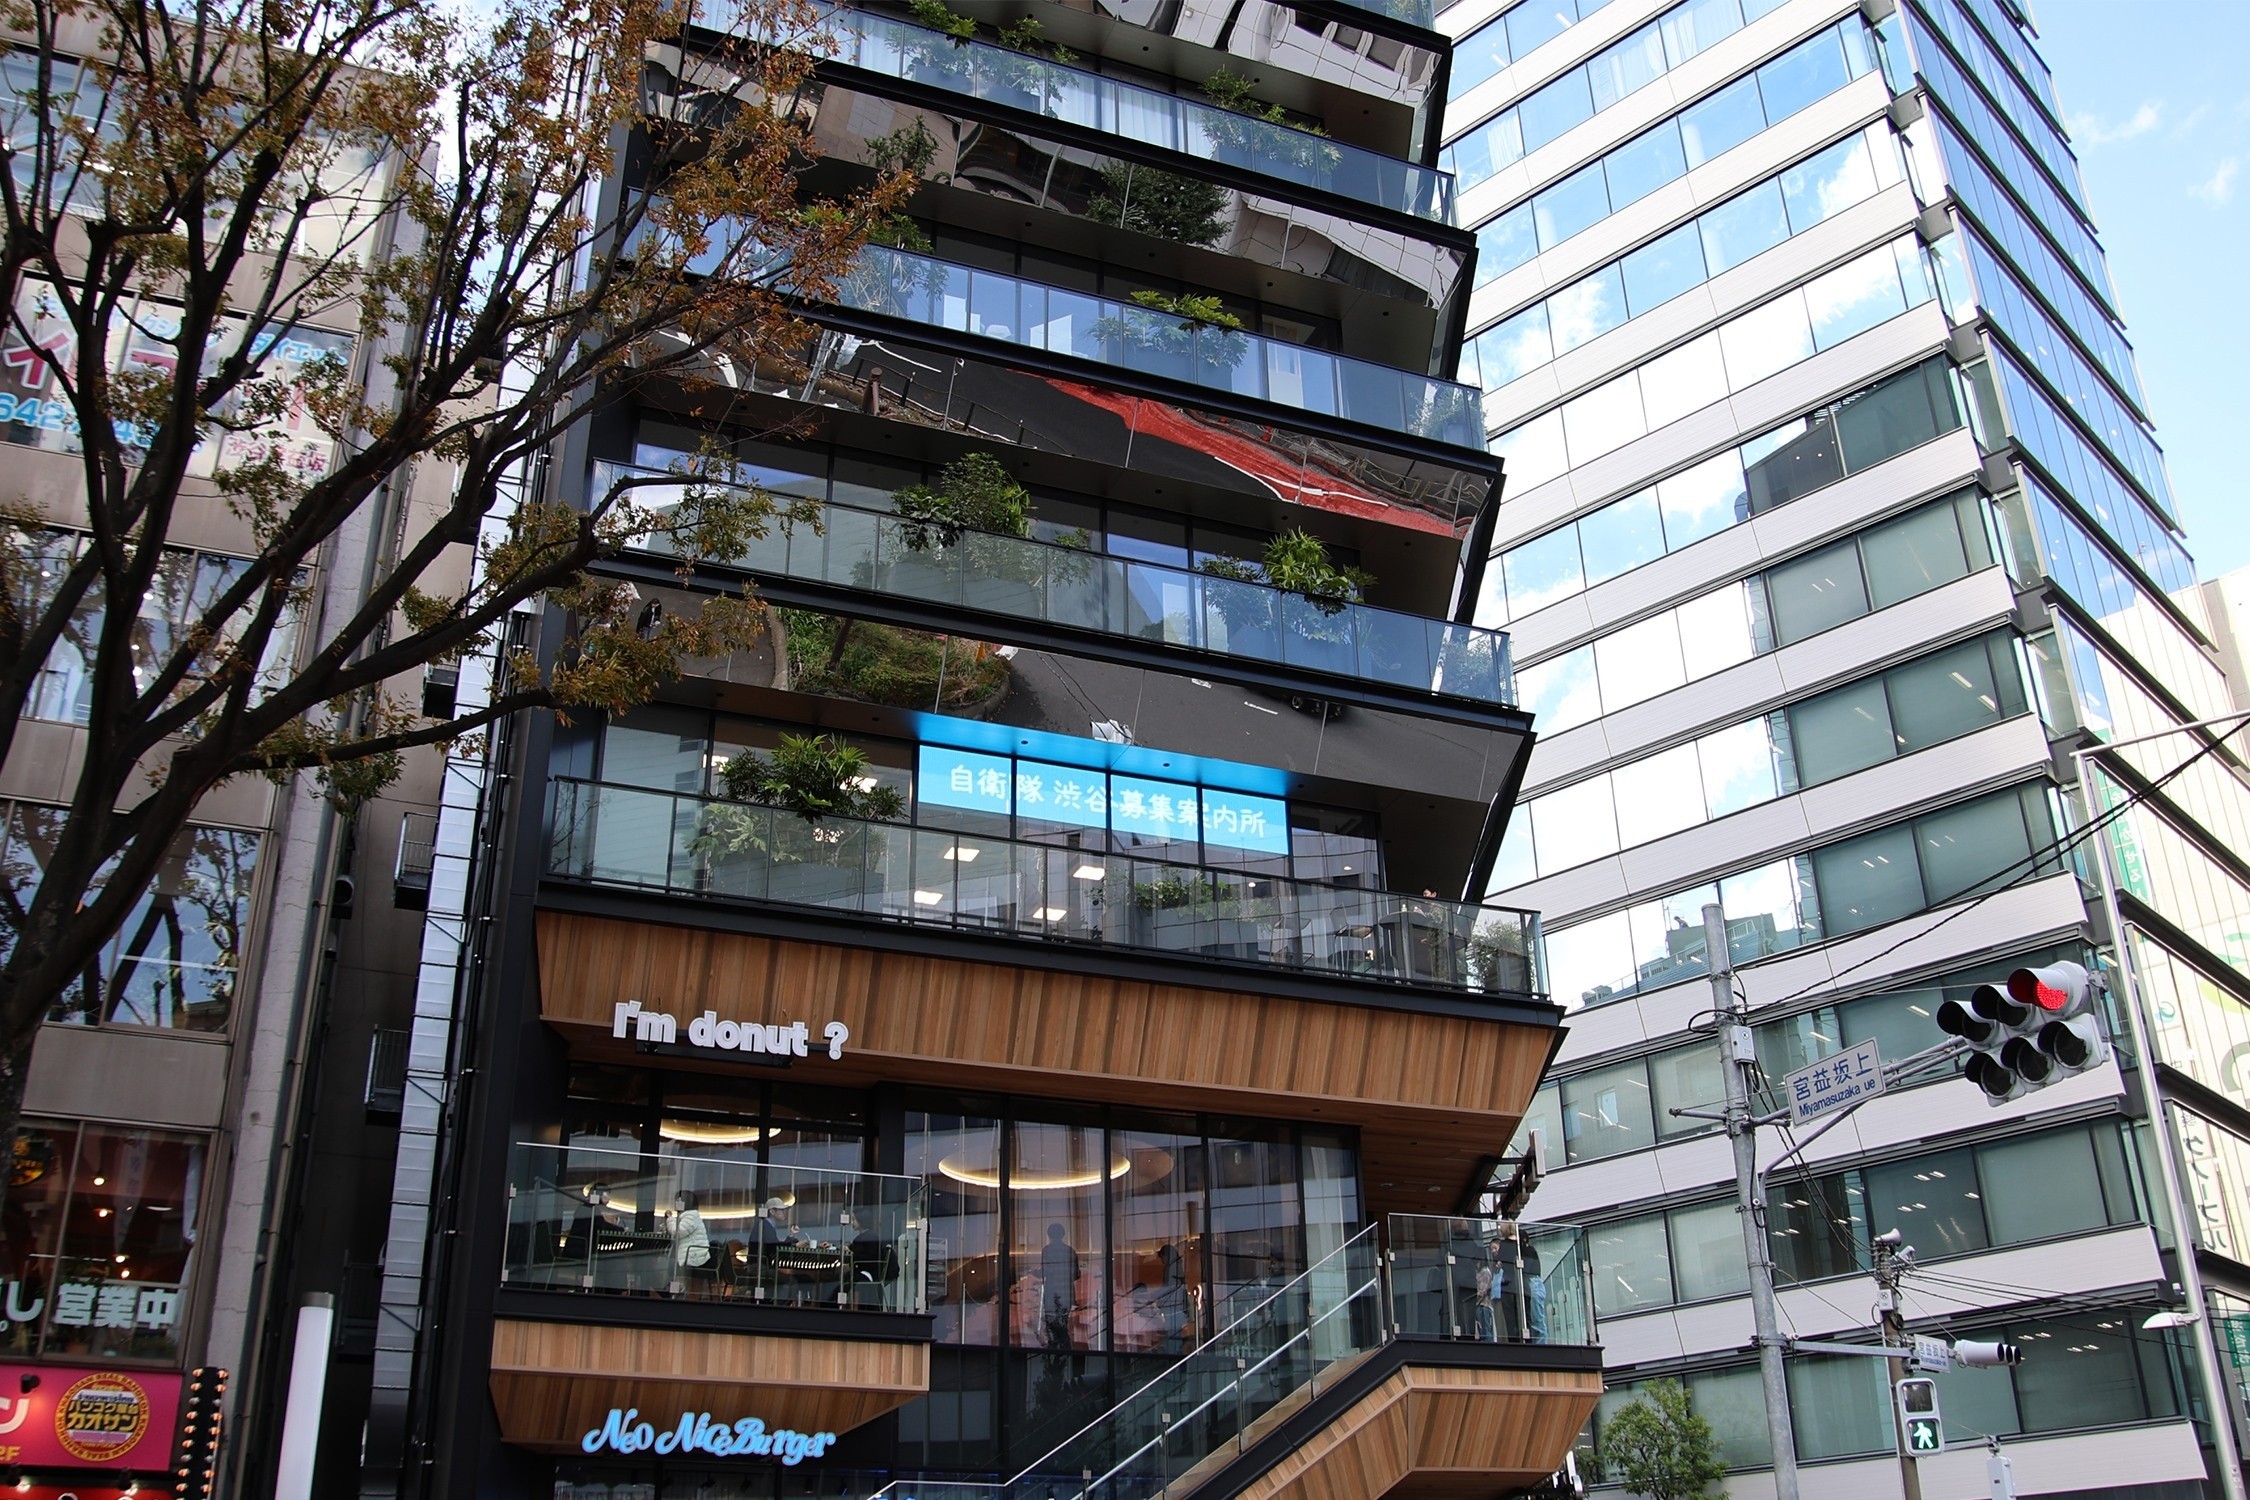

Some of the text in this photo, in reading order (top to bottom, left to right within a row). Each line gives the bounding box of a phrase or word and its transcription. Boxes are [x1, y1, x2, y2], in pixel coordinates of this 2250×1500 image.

[612, 1000, 849, 1061] I'm donut ?
[1793, 1052, 1873, 1102] 宮益坂上
[1798, 1078, 1876, 1118] Miyamasuzaka ue
[0, 1280, 178, 1329] し営業中
[67, 1411, 139, 1432] カオサン
